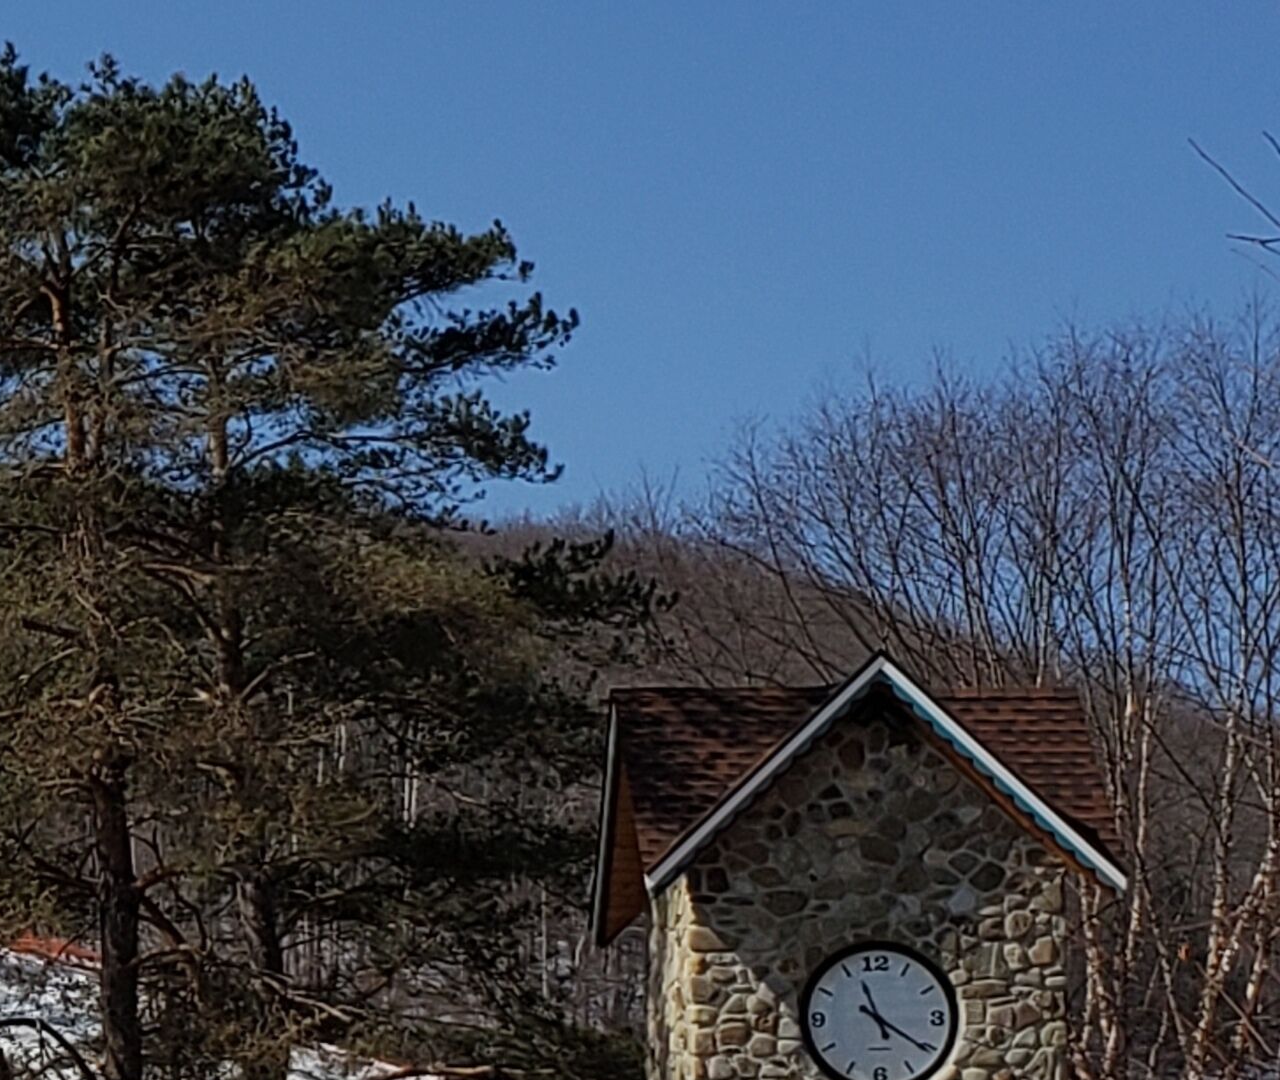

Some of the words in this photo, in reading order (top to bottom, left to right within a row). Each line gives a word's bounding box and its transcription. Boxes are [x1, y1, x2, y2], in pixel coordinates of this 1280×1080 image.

[862, 955, 889, 972] 12
[811, 1011, 826, 1028] 9
[930, 1010, 945, 1027] 3
